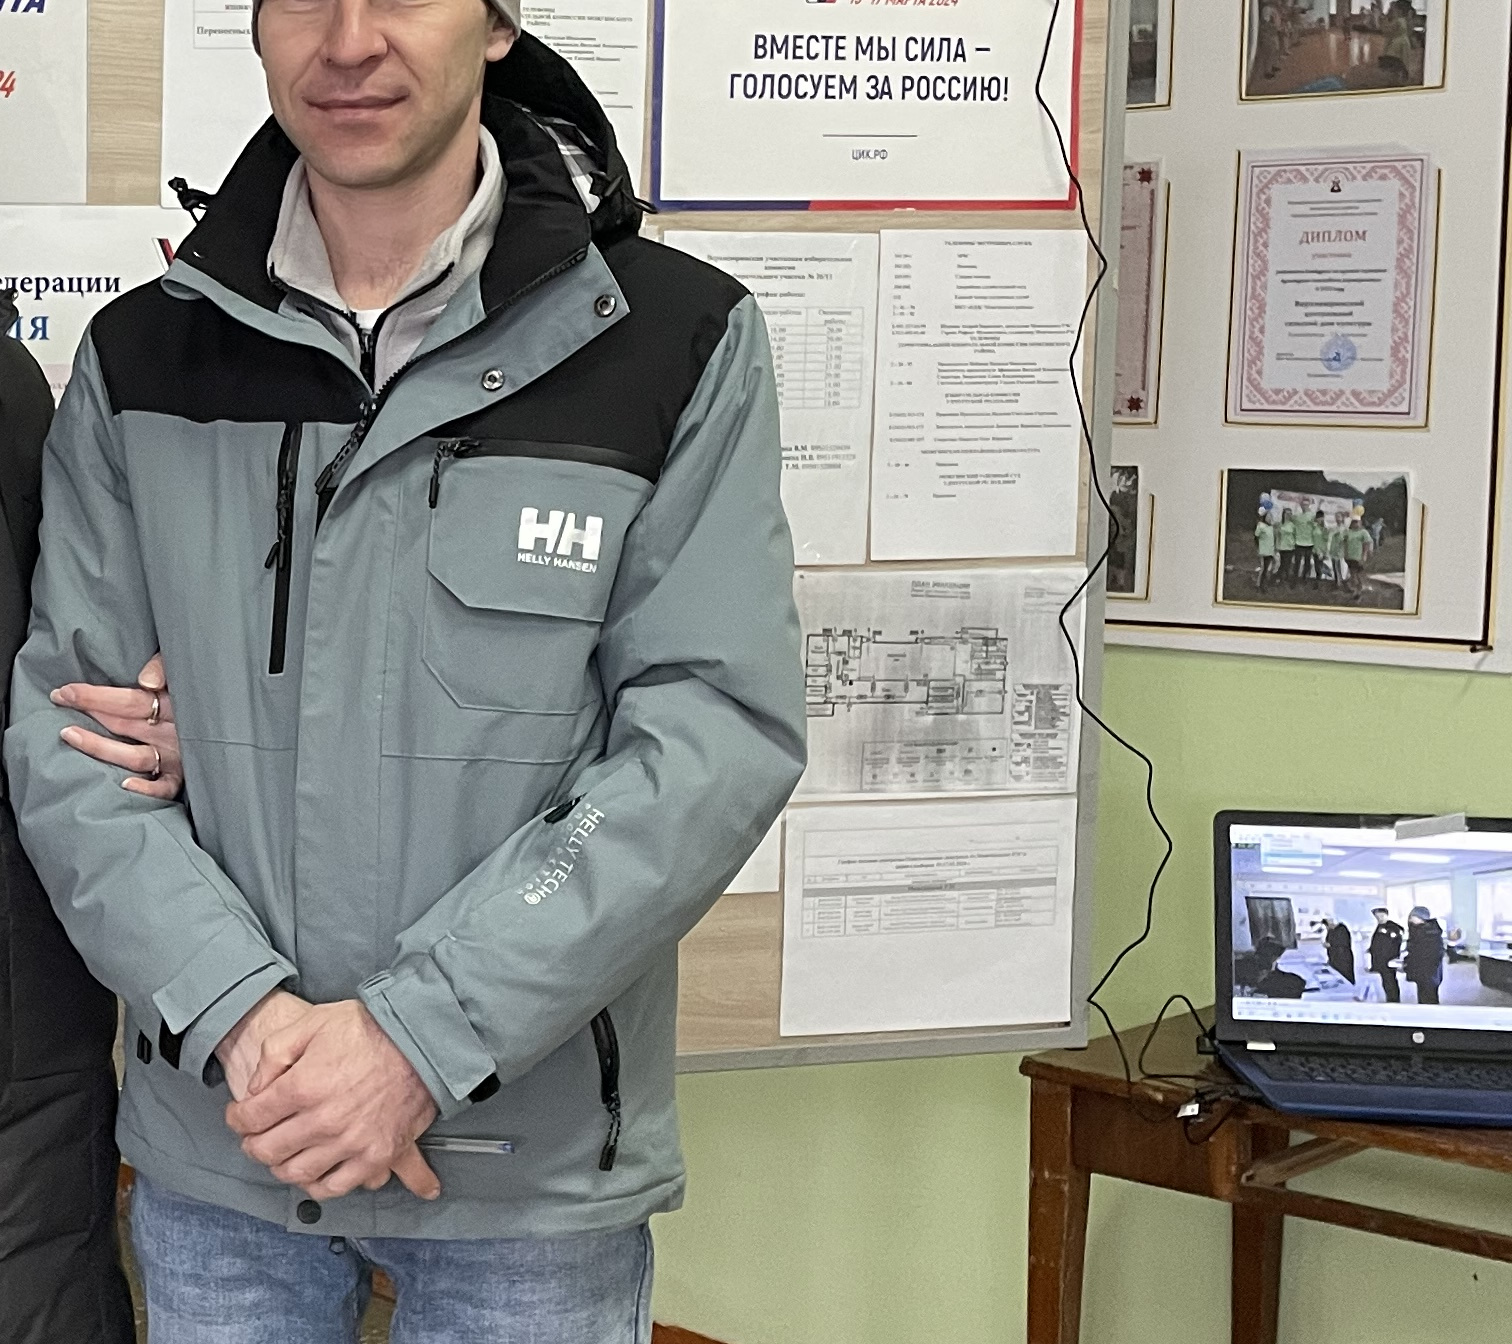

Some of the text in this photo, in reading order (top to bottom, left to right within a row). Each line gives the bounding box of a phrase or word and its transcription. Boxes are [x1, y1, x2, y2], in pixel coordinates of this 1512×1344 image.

[754, 34, 847, 61] ВМЕСТЕ
[855, 36, 896, 62] МЫ
[905, 37, 967, 63] СИЛА
[729, 73, 1009, 102] ГОЛОСУЕМ ЗА РОССИЮ!
[852, 149, 888, 160] ЦИК.РФ
[1299, 230, 1368, 245] ДИПЛОМ
[517, 553, 597, 573] HELLY HANSEN
[565, 808, 605, 860] HELLY
